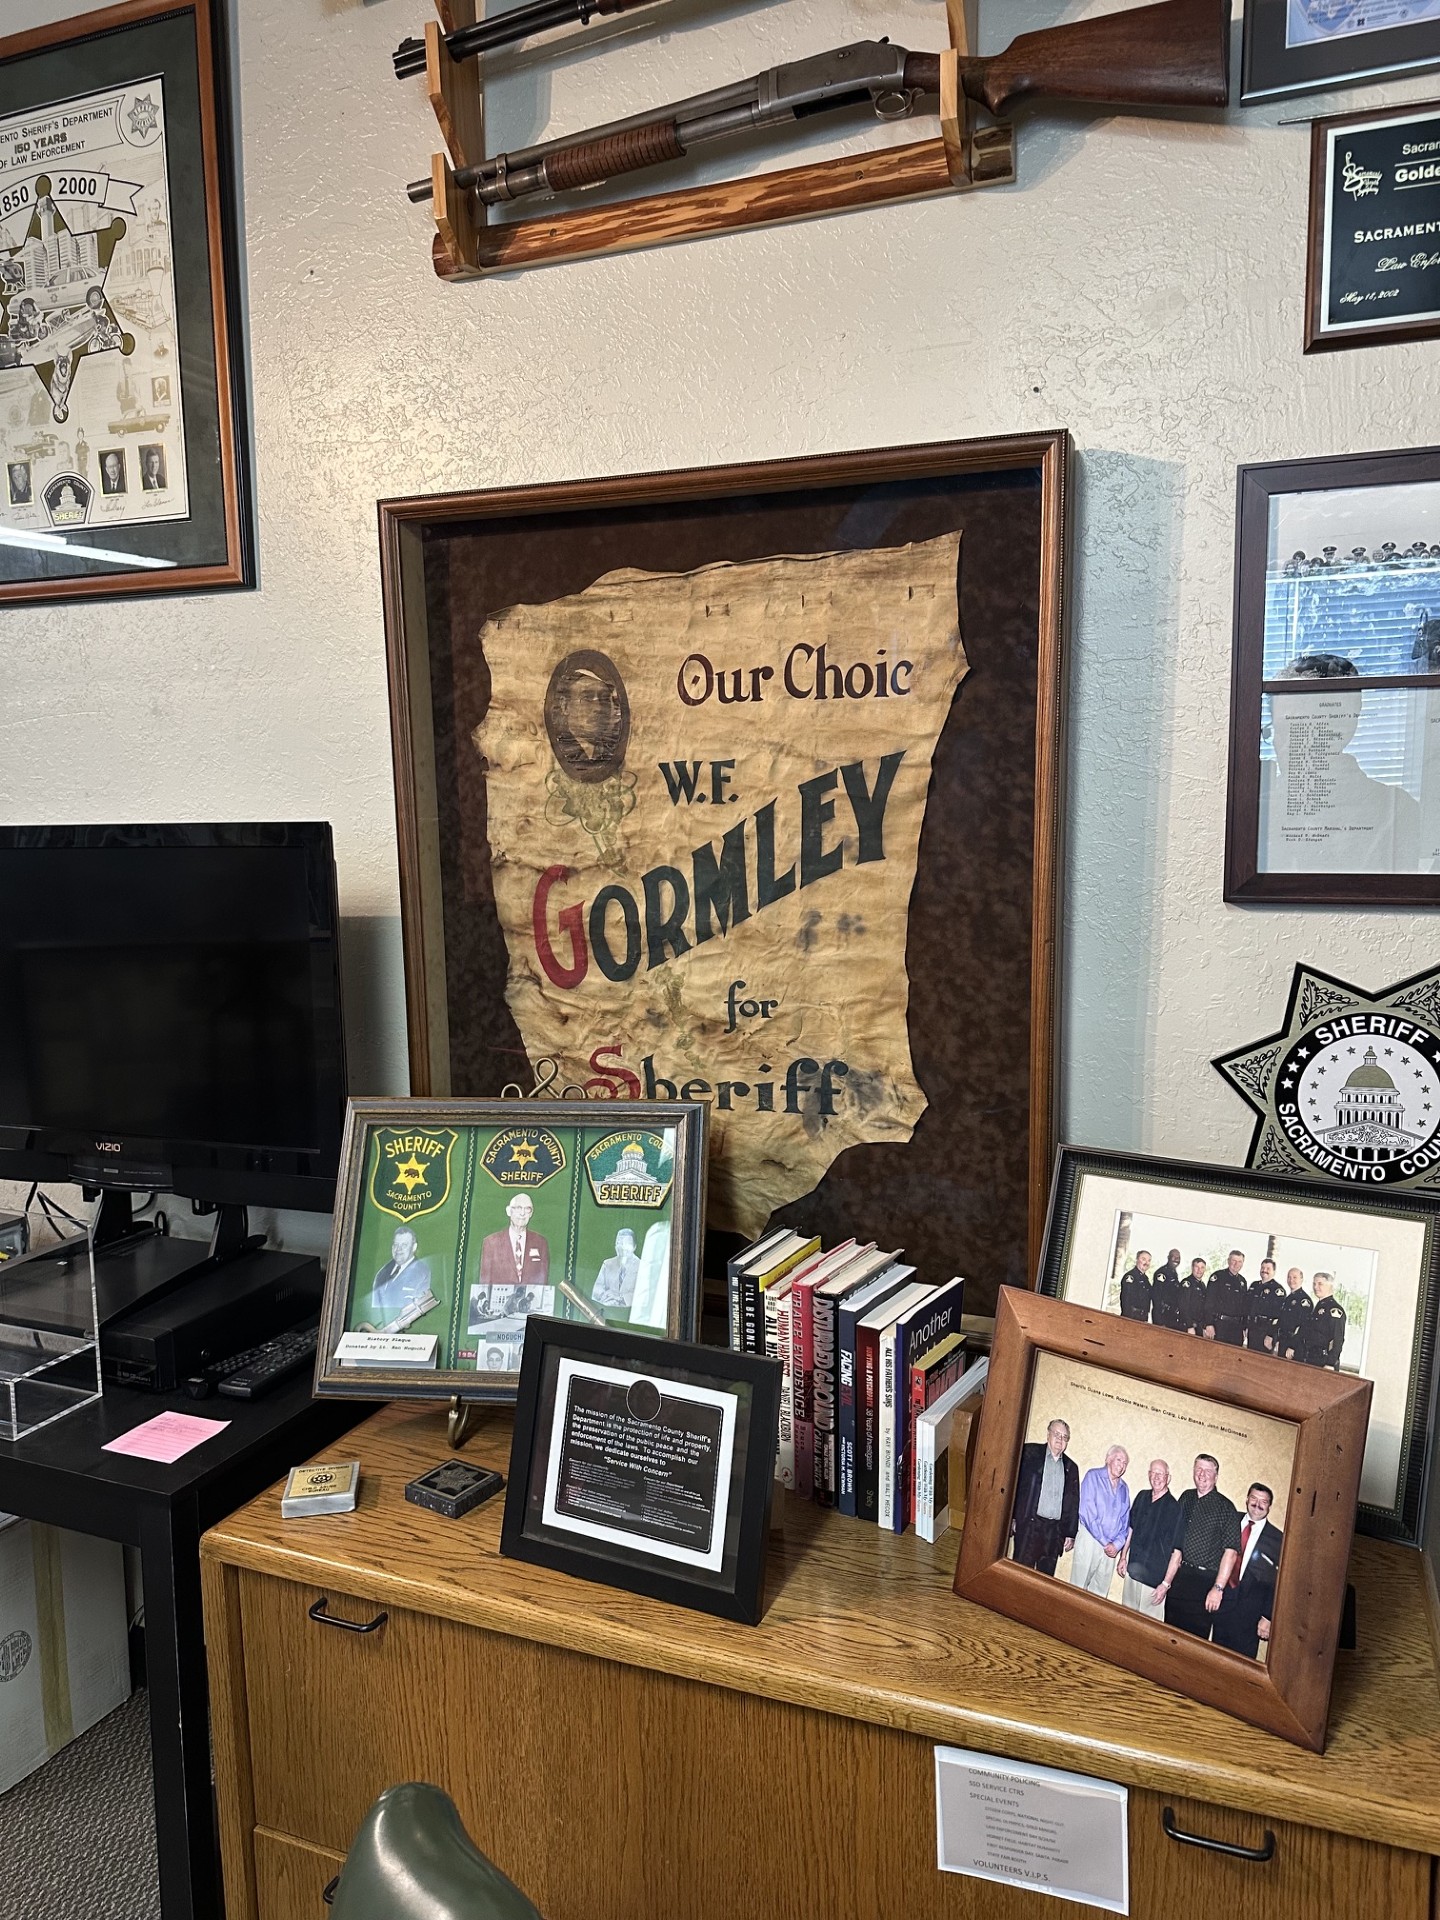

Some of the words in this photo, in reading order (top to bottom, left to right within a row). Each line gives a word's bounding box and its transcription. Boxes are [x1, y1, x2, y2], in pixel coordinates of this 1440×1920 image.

[22, 120, 59, 138] SHERIFF'S
[62, 107, 113, 128] DEPARTMENT
[11, 154, 28, 166] LAW
[31, 141, 85, 161] ENFORCEMENT
[14, 142, 31, 154] 150
[33, 132, 67, 150] YEARS
[58, 177, 97, 196] 2000
[1375, 257, 1407, 272] Law
[1340, 291, 1364, 305] May
[1378, 289, 1399, 298] 2002
[55, 511, 83, 521] SHERIFF
[677, 653, 776, 707] Our
[784, 643, 914, 700] Choic
[658, 759, 739, 806] W.F.
[532, 750, 907, 989] GORMLEY
[724, 980, 778, 1033] for
[1315, 1015, 1429, 1045] SHERIFF
[583, 1044, 849, 1116] Sheriff
[96, 1142, 121, 1152] VIZIO
[386, 1136, 445, 1158] SHERIFF
[486, 1128, 539, 1163] SACRAMENTO
[539, 1134, 561, 1166] COUNTY
[591, 1133, 642, 1160] SACRAMENTO
[1279, 1103, 1386, 1181] SACRAMENTO
[500, 1171, 544, 1182] SHERIFF
[386, 1189, 432, 1202] SACRAMENTO
[600, 1184, 661, 1201] SHERIFF
[393, 1201, 422, 1210] COUNTY
[746, 1307, 754, 1317] BE
[792, 1290, 802, 1339] TRACE
[746, 1322, 755, 1346] GONE
[766, 1315, 777, 1336] ALL
[777, 1310, 790, 1343] HUMAN
[813, 1296, 834, 1369] DISTURBED
[909, 1307, 953, 1356] Another
[841, 1349, 852, 1387] FACING
[793, 1344, 805, 1418] EVIDENCE
[885, 1369, 893, 1393] FATHER'S
[813, 1369, 835, 1431] GROUND
[841, 1386, 852, 1406] EVIL
[884, 1394, 892, 1408] SINS
[1088, 1387, 1101, 1395] Duane
[1116, 1396, 1131, 1404] Robbie
[573, 1413, 605, 1427] Department
[623, 1426, 652, 1437] protection
[661, 1433, 670, 1442] life
[672, 1436, 683, 1444] and
[574, 1405, 584, 1413] The
[586, 1409, 608, 1419] mission
[616, 1415, 625, 1423] the
[627, 1418, 661, 1431] Sacramento
[663, 1426, 684, 1437] County
[686, 1431, 711, 1443] Sheriff's
[781, 1410, 791, 1442] BLACKBURN
[571, 1431, 606, 1444] enforcement
[615, 1439, 623, 1447] the
[643, 1445, 651, 1453] To
[652, 1448, 685, 1463] accomplish
[688, 1457, 698, 1465] our
[583, 1425, 617, 1437] preservation
[626, 1434, 635, 1442] the
[637, 1437, 654, 1447] public
[656, 1442, 673, 1452] peace
[676, 1444, 688, 1453] and
[690, 1448, 699, 1457] the
[605, 1445, 629, 1458] dedicate
[630, 1452, 658, 1465] ourselves
[629, 1462, 643, 1471] With
[814, 1456, 822, 1488] NORTON
[865, 1490, 873, 1507] Shelby
[969, 1768, 1009, 1780] COMMUNITY
[1011, 1777, 1040, 1787] POLICING
[982, 1783, 1007, 1793] SERVICE
[1009, 1788, 1024, 1796] CTRS
[970, 1793, 994, 1802] SPECIAL
[996, 1797, 1019, 1807] EVENTS
[973, 1859, 1022, 1875] VOLUNTEERS
[1024, 1870, 1050, 1881] V.I.P.S.
